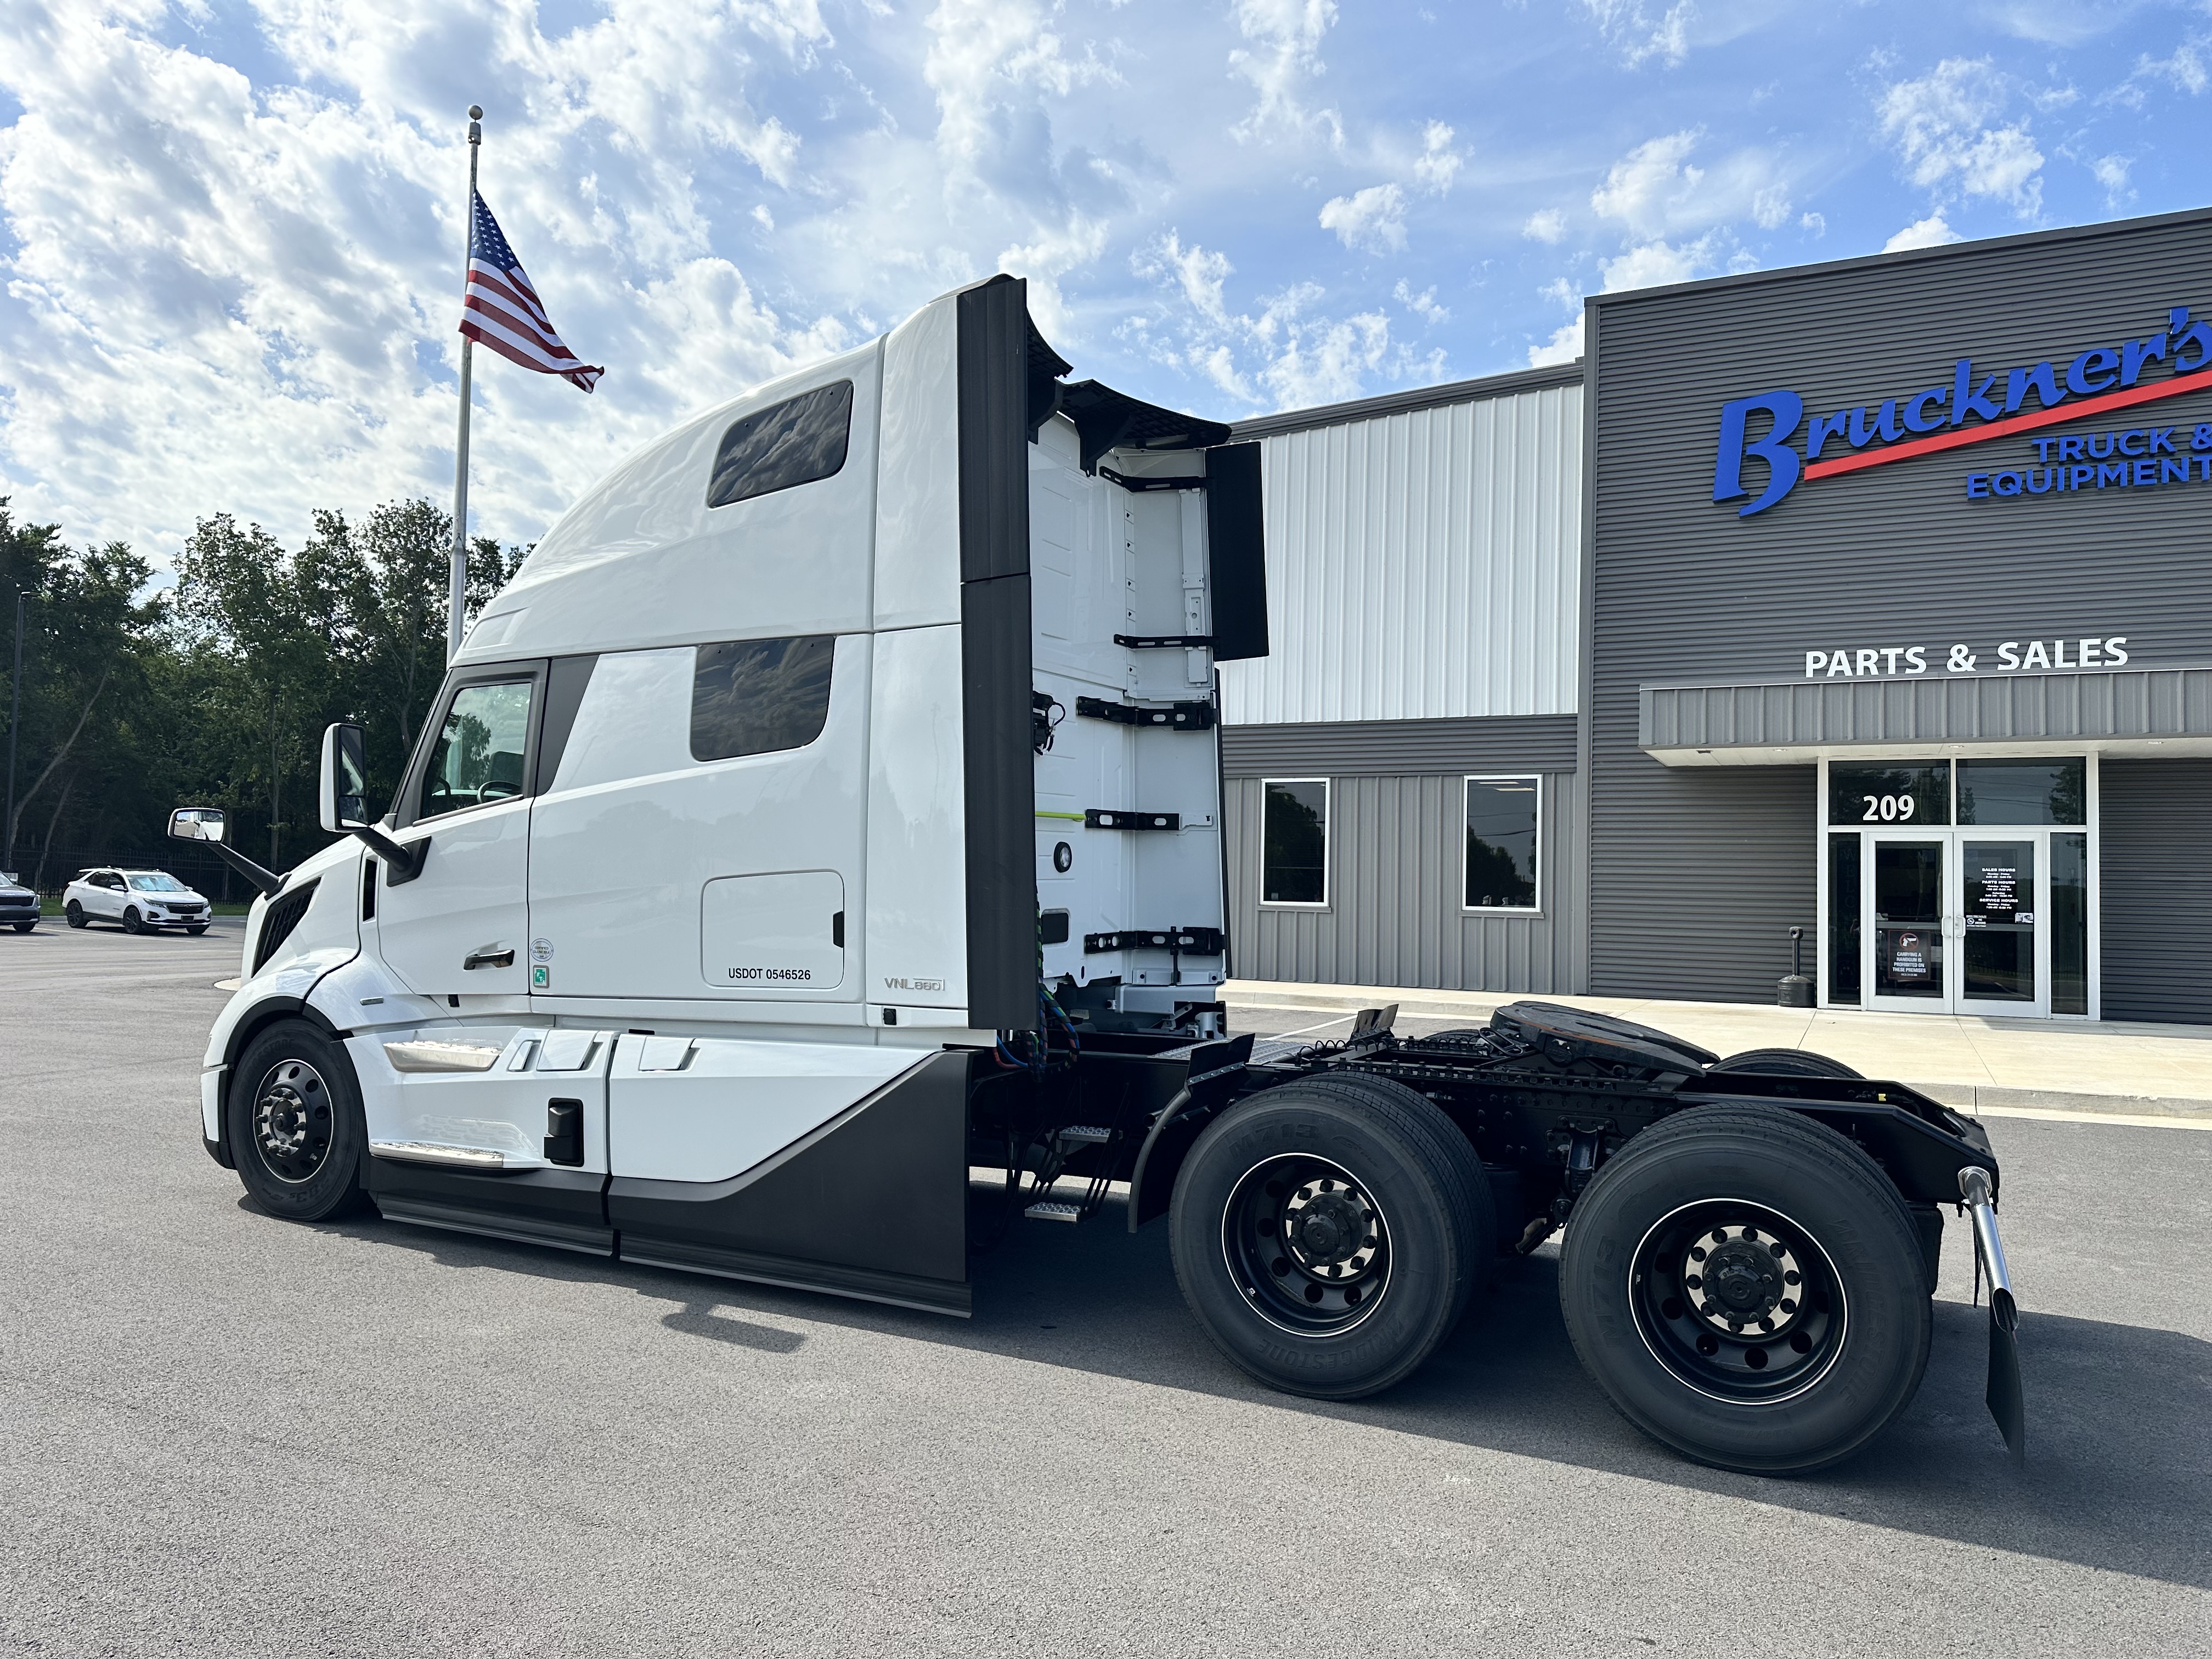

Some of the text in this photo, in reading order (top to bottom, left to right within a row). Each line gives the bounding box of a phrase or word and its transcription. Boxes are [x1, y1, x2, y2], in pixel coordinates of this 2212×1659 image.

[1713, 306, 2211, 517] Bruckner's
[2031, 422, 2211, 464] TRUCK &
[1967, 454, 2211, 499] EQUIPMENT
[1805, 637, 2129, 678] PARTS & SALES
[1863, 795, 1915, 821] 209
[729, 968, 811, 980] USDOT 0546526
[884, 978, 915, 990] VNL
[1228, 1122, 1319, 1160] M713
[1256, 1310, 1406, 1372] BRIDGESTONE
